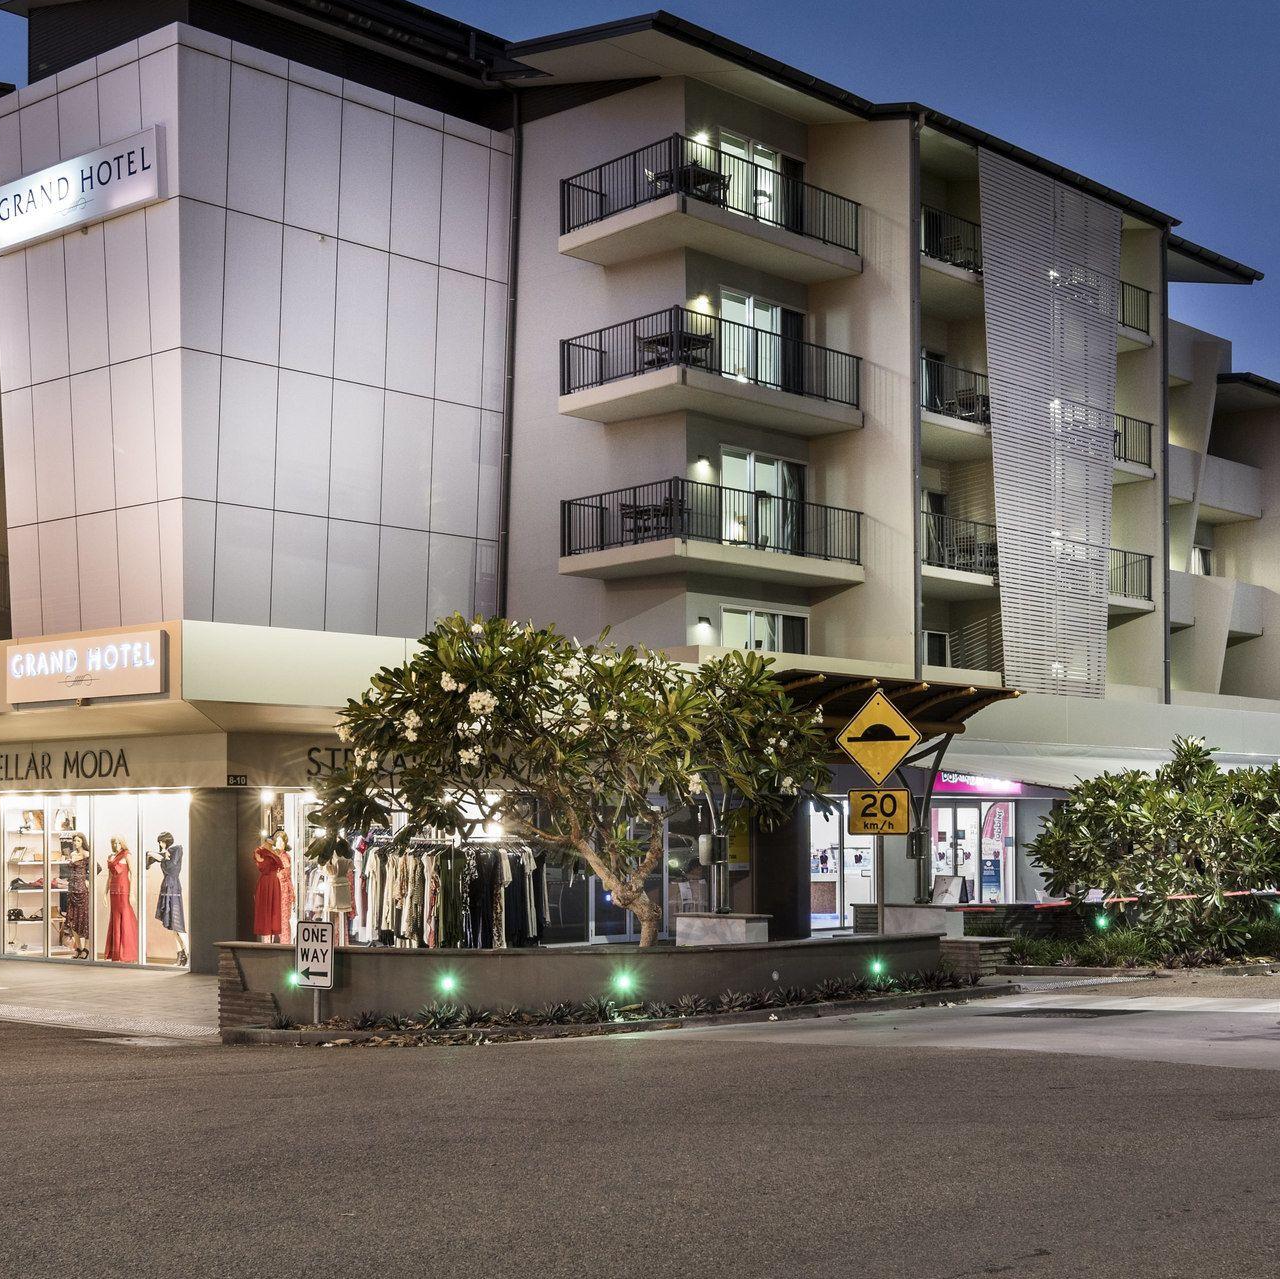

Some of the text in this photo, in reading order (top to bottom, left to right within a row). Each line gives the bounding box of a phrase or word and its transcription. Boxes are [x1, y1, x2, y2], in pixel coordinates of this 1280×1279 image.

[80, 146, 152, 193] HOTEL
[10, 641, 156, 679] GRAND HOTEL
[62, 748, 131, 780] MODA
[229, 776, 246, 785] 8-10
[860, 793, 898, 818] 20
[863, 820, 895, 830] km/h
[302, 927, 328, 943] ONE
[300, 947, 329, 963] WAY
